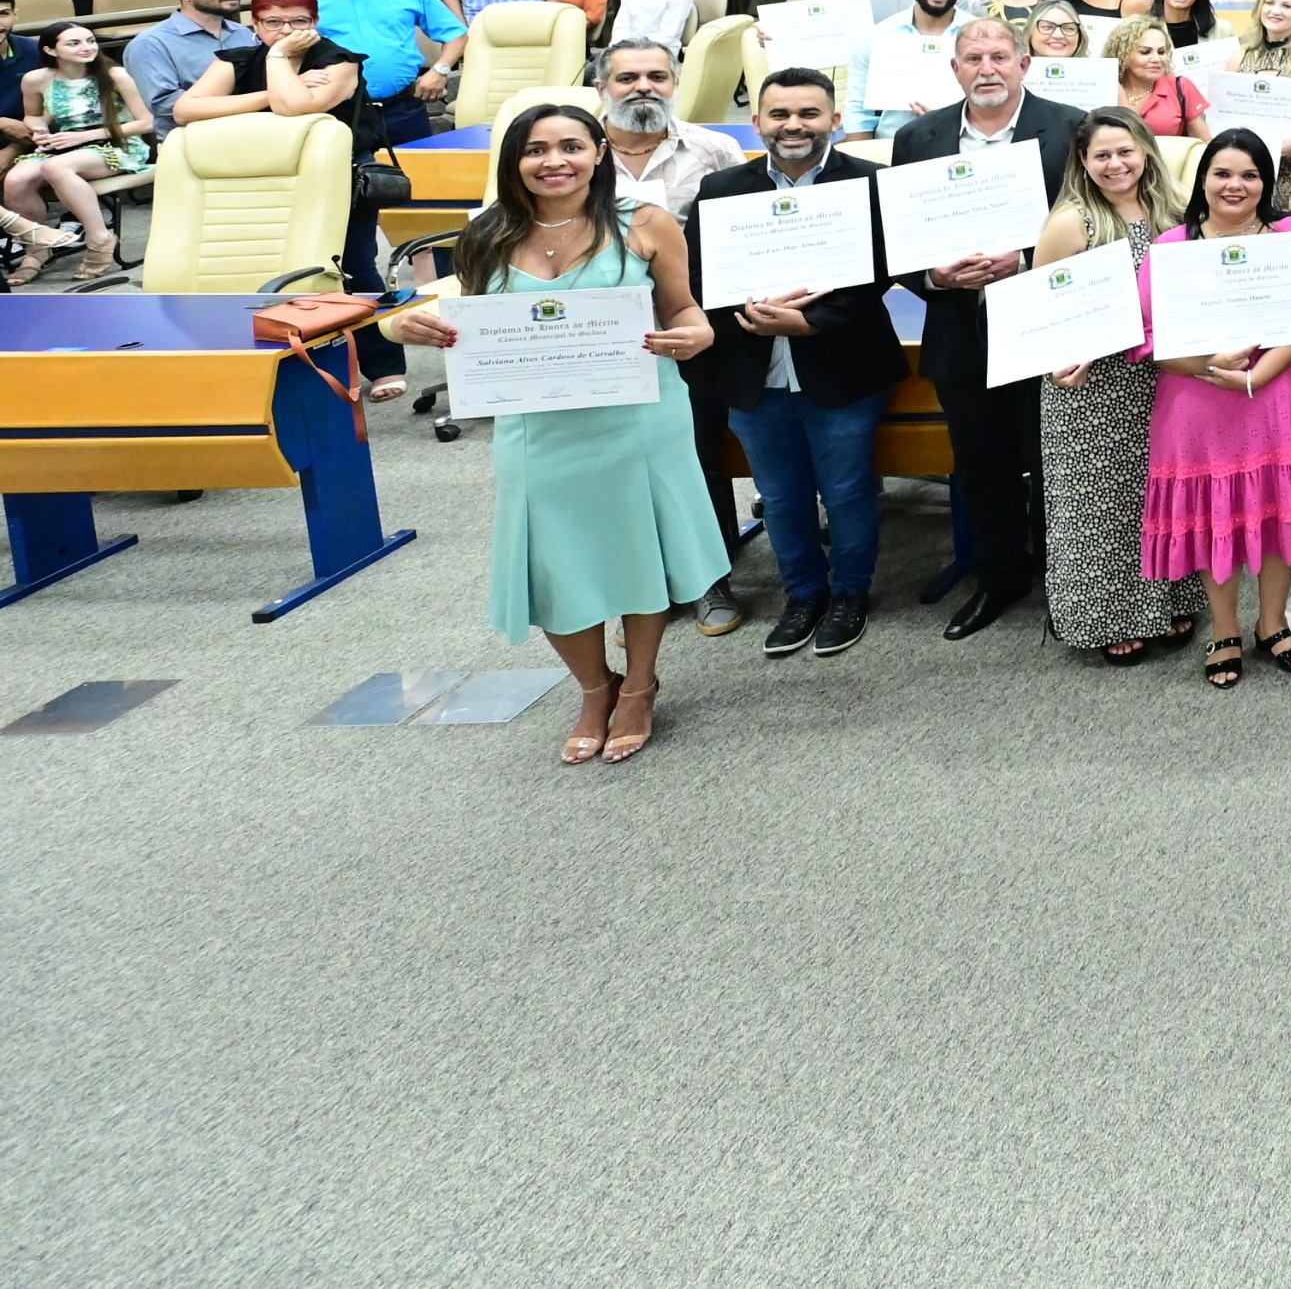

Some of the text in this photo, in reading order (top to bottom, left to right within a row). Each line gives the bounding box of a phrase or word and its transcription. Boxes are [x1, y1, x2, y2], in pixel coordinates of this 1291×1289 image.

[479, 325, 521, 337] Diploma
[524, 324, 534, 332] de
[539, 322, 569, 331] Honra
[586, 319, 619, 328] Mérito
[476, 356, 514, 367] Salviana
[517, 355, 538, 364] Alves
[540, 352, 574, 362] Cardoso
[576, 351, 586, 359] de
[588, 348, 625, 358] Carvalho
